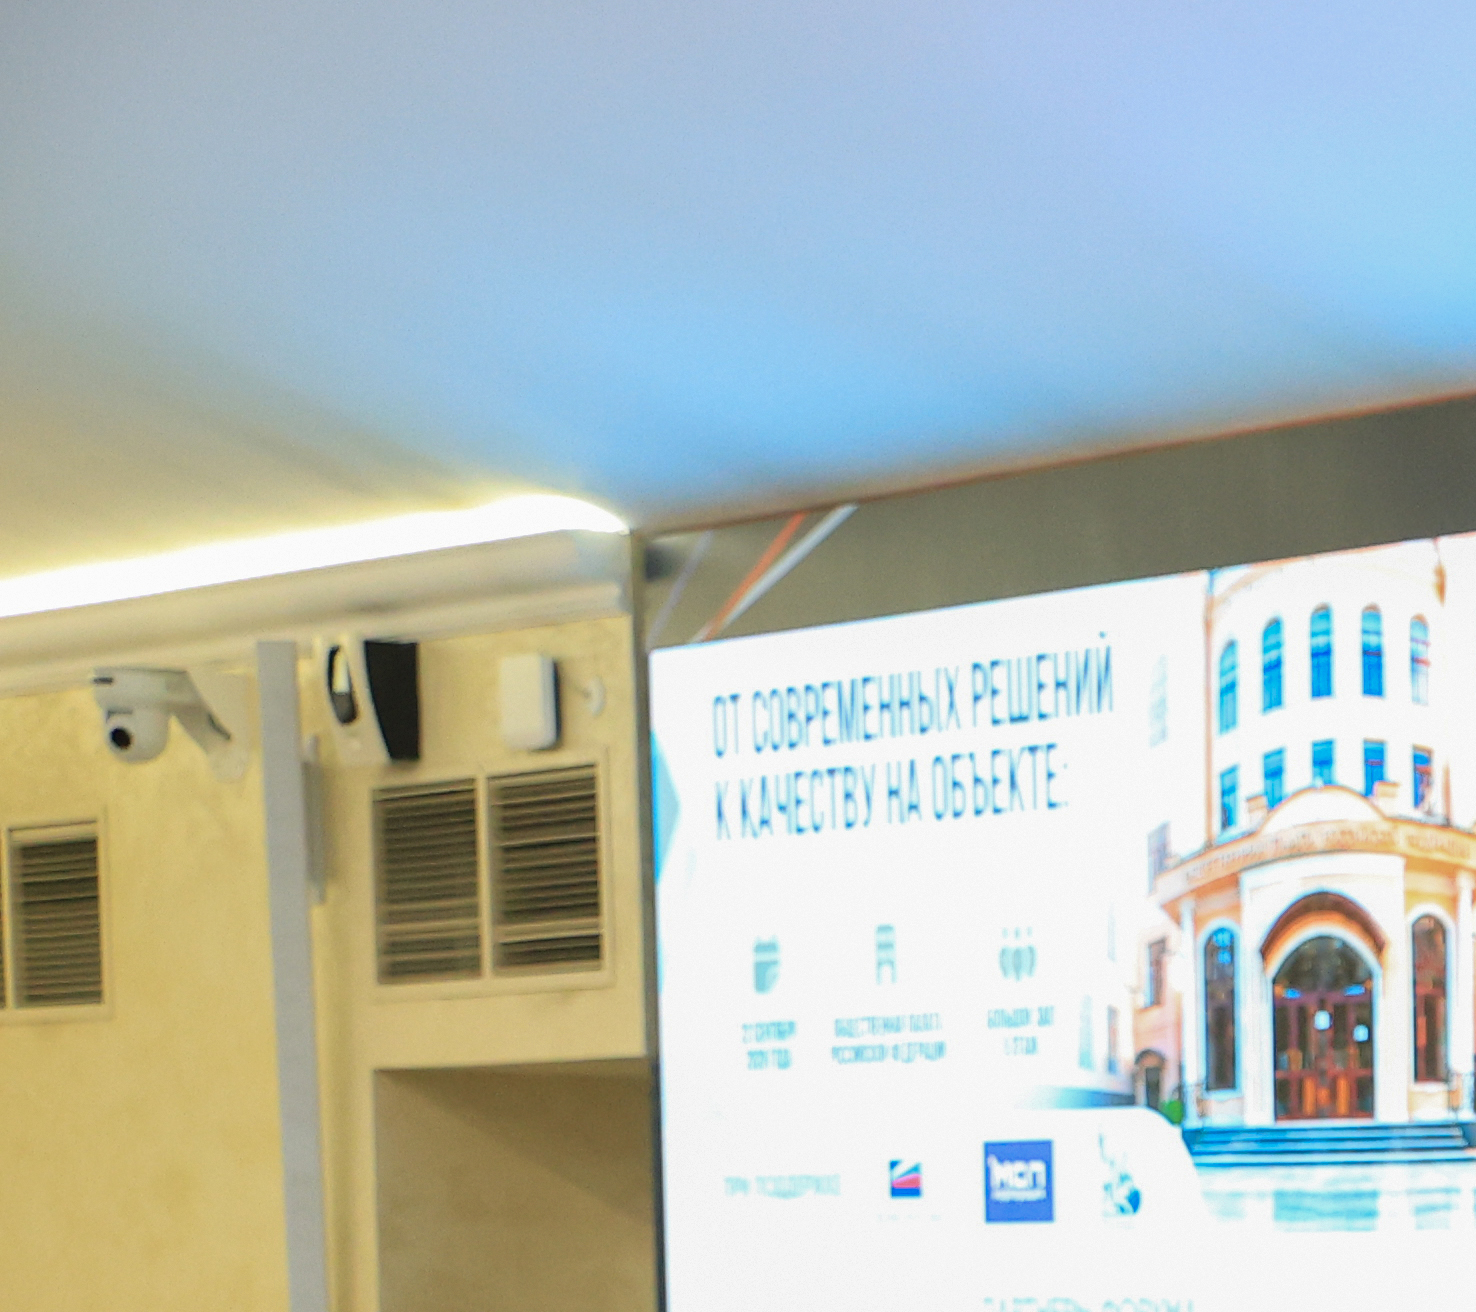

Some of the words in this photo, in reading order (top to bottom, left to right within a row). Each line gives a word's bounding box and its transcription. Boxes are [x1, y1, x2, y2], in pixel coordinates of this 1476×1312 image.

[712, 692, 743, 759] ОТ
[752, 665, 962, 754] СОВРЕМЕННЫХ
[970, 630, 1114, 728] РЕШЕНИЙ
[714, 780, 732, 840] К
[739, 762, 877, 840] КАЧЕСТВУ
[886, 758, 923, 824] НА
[931, 742, 1070, 821] ОБЪЕКТЕ:
